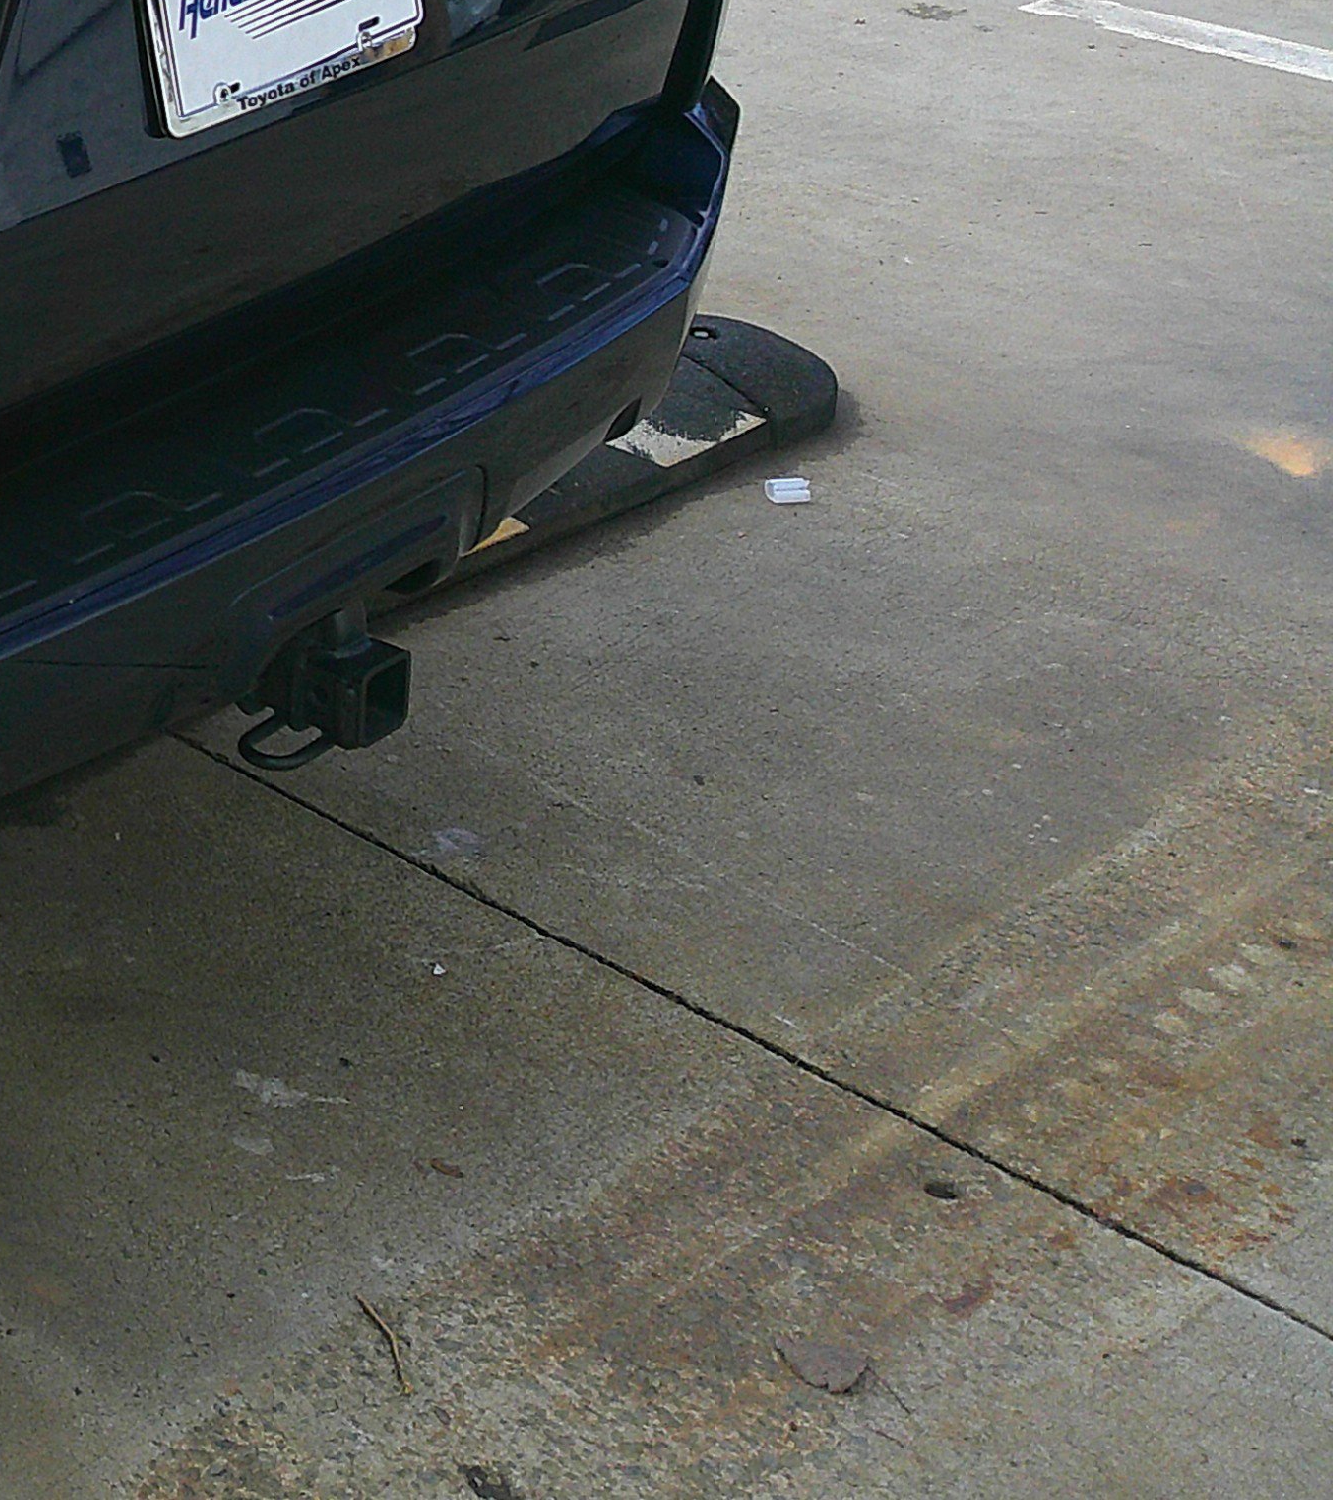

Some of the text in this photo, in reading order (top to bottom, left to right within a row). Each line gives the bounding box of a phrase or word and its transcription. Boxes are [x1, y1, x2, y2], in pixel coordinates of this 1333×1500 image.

[236, 56, 362, 111] Toyota of Apex
